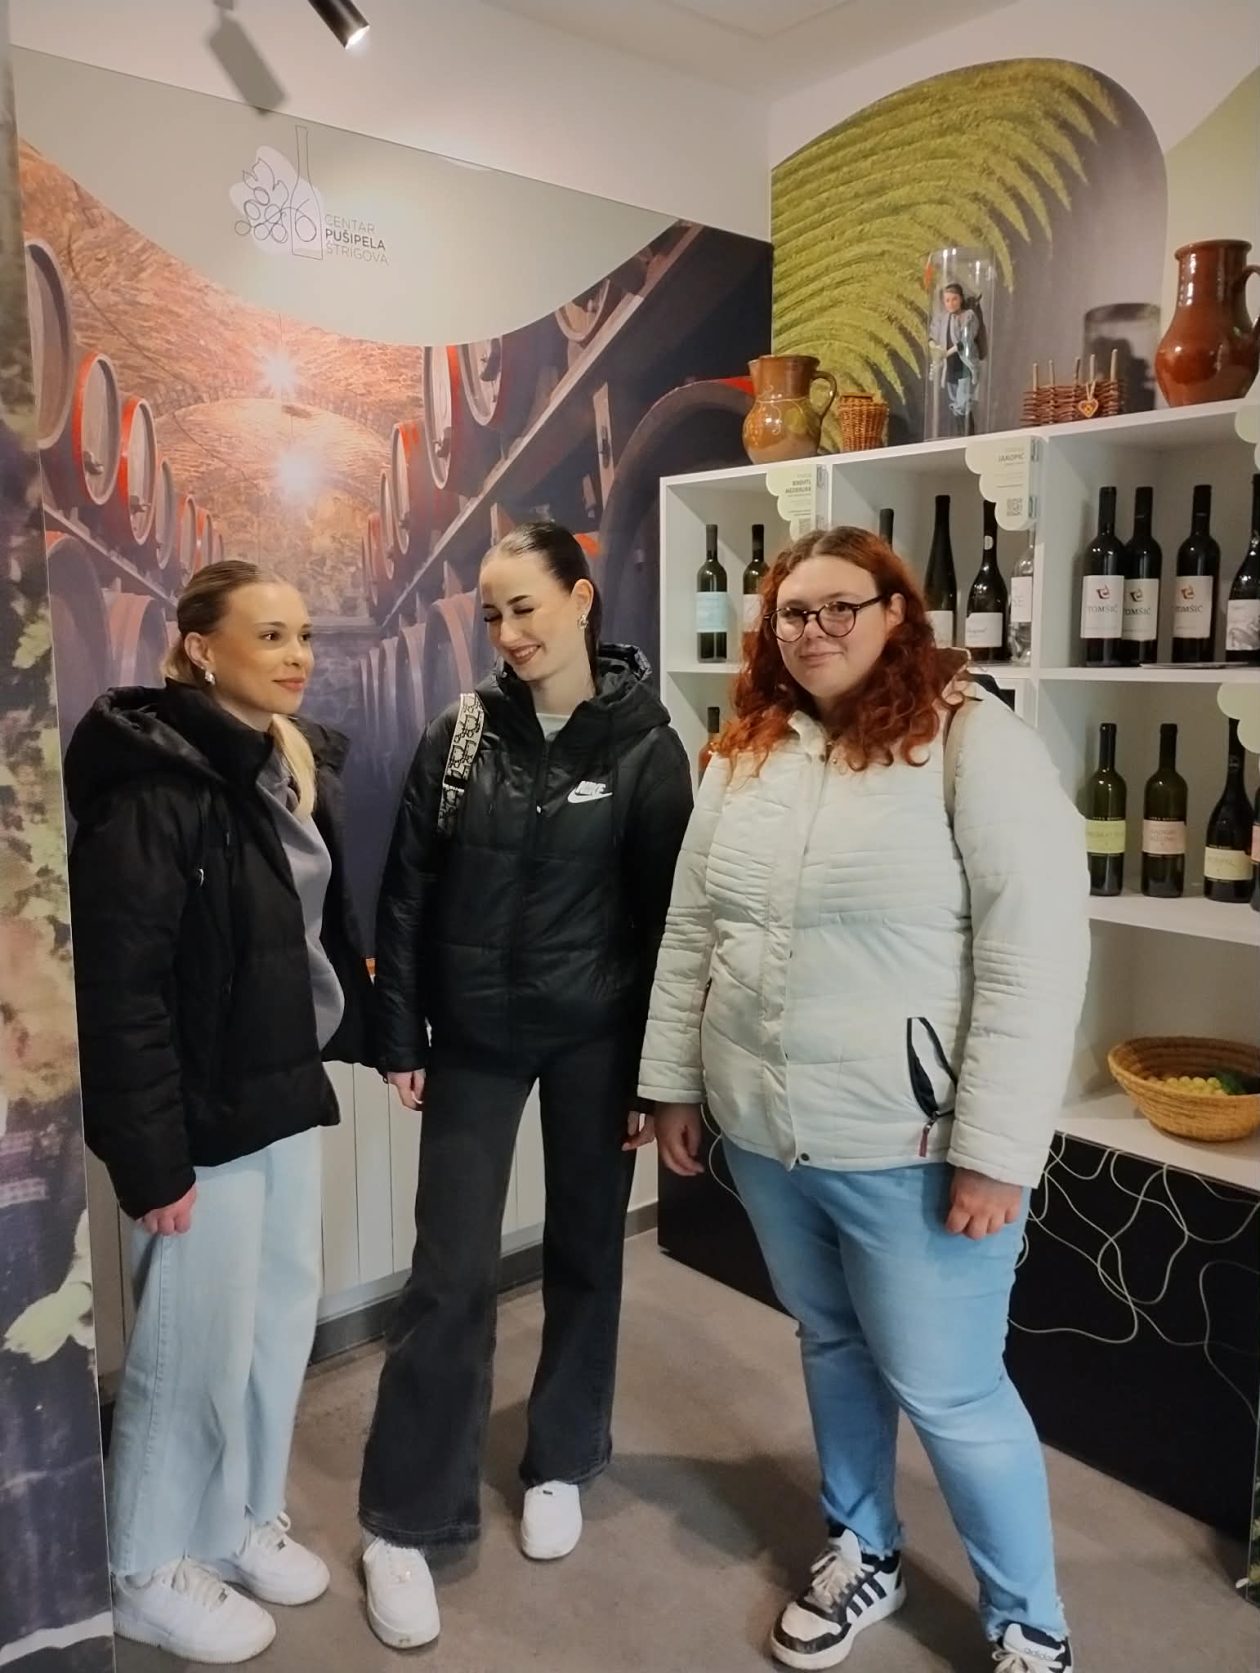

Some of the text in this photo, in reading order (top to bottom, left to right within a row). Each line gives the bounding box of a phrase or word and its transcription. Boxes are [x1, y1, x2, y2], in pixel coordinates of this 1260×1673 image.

[324, 214, 376, 233] CENTAR
[325, 228, 386, 250] PUŠIPELA
[326, 241, 389, 264] ŠTRIGOVA
[575, 781, 606, 794] NIKE
